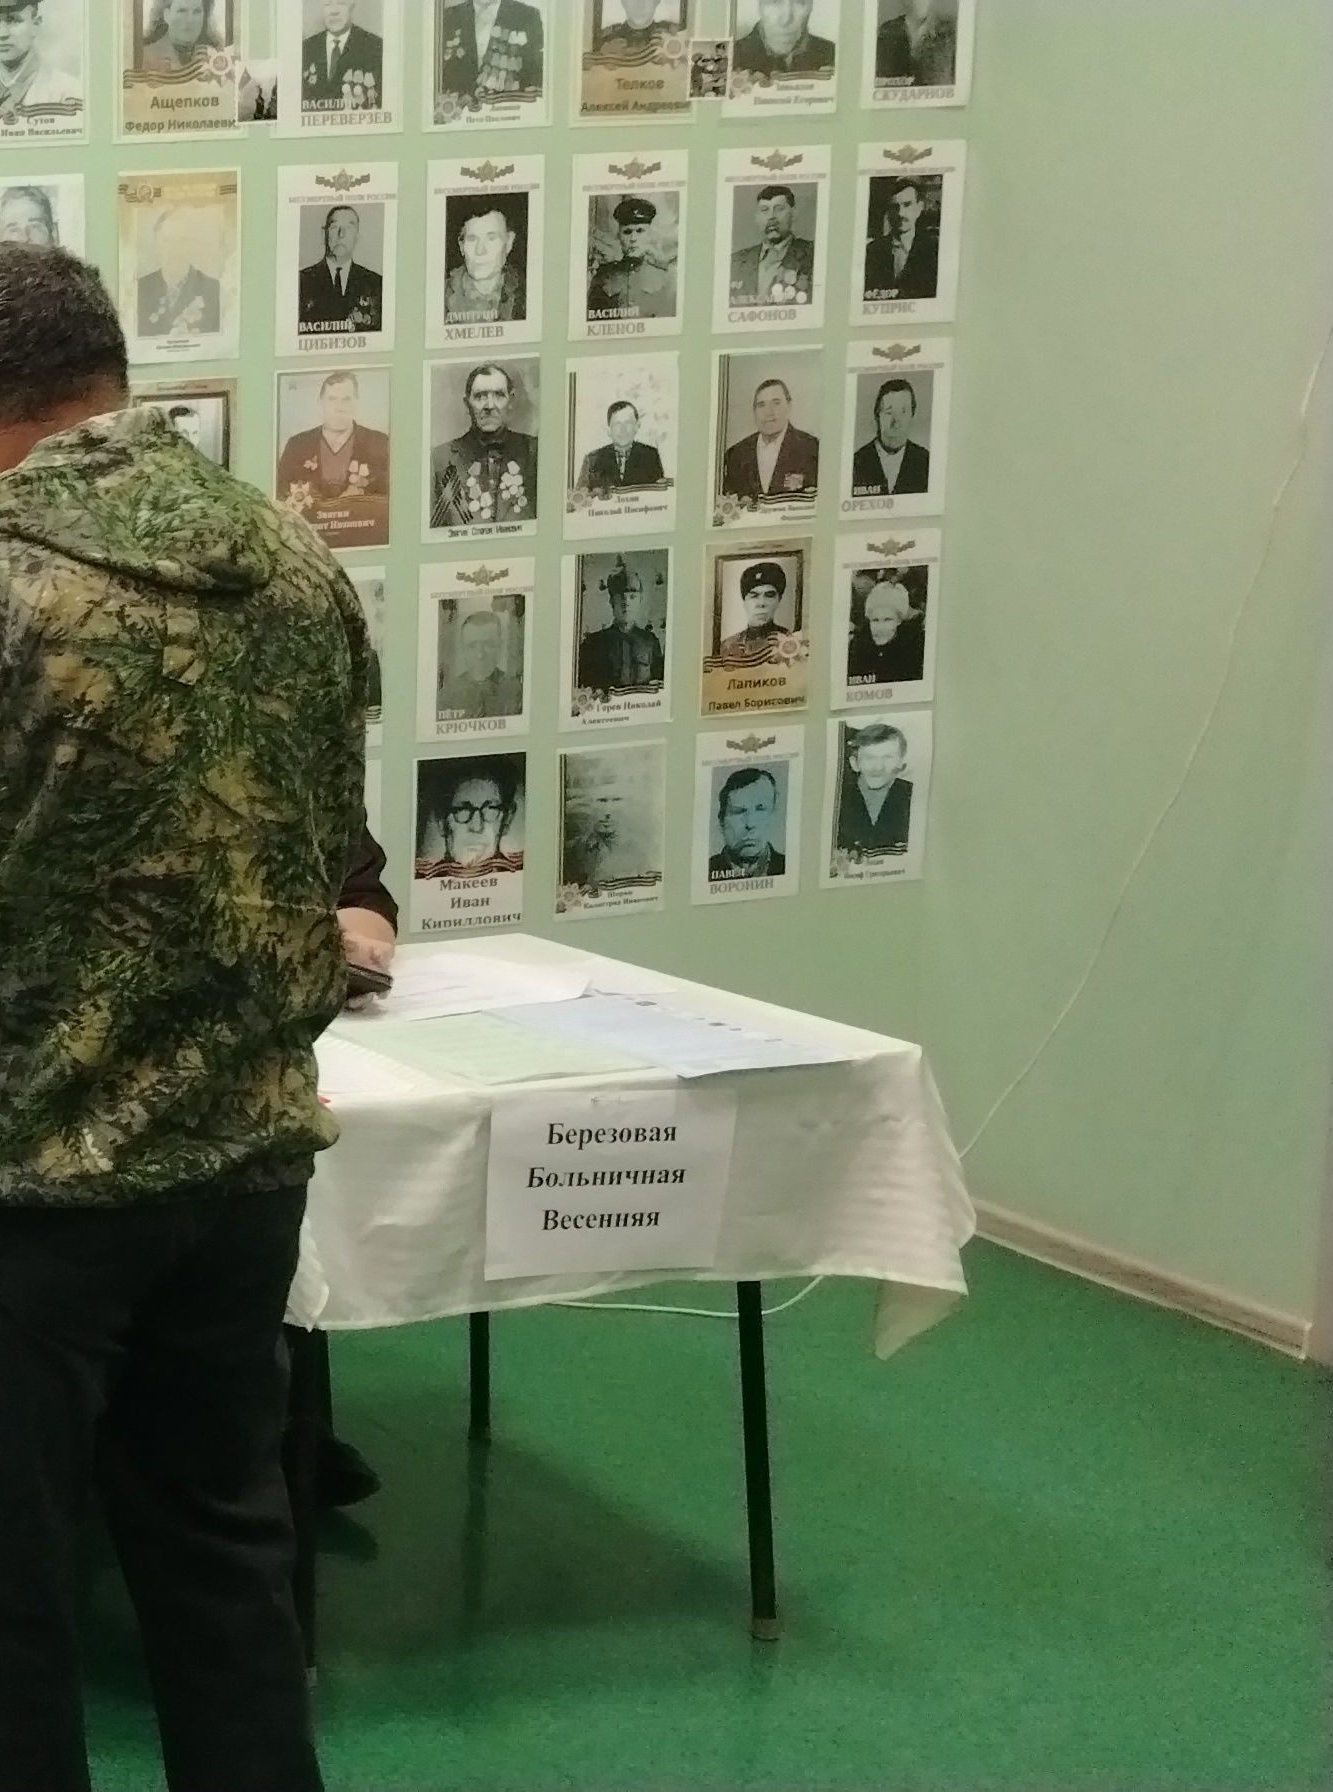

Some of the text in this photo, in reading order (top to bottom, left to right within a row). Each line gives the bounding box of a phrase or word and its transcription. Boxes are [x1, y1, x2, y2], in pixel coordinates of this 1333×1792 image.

[150, 96, 219, 110] Ащепков
[125, 118, 236, 132] Федор Николаеви
[301, 112, 392, 127] ПЕРЕВЕРЗЕВ
[727, 309, 796, 324] САФОНОВ
[445, 326, 504, 341] ХМЕЛЕВ
[587, 322, 645, 336] КЛЕНОВ
[298, 337, 367, 352] ЦИБИЗОВ
[841, 498, 893, 512] ОРЕХОВ
[727, 678, 786, 690] Лапиков
[709, 695, 805, 710] Павел Борисович
[436, 719, 506, 735] КРЮЧКОВ
[440, 878, 497, 892] Макеев
[710, 879, 774, 895] ВОРОНИН
[451, 897, 489, 909] Иван
[421, 913, 521, 930] Кириллович
[547, 1123, 677, 1150] Березовая
[526, 1166, 686, 1188] Больничная
[542, 1209, 659, 1230] Весенняя
